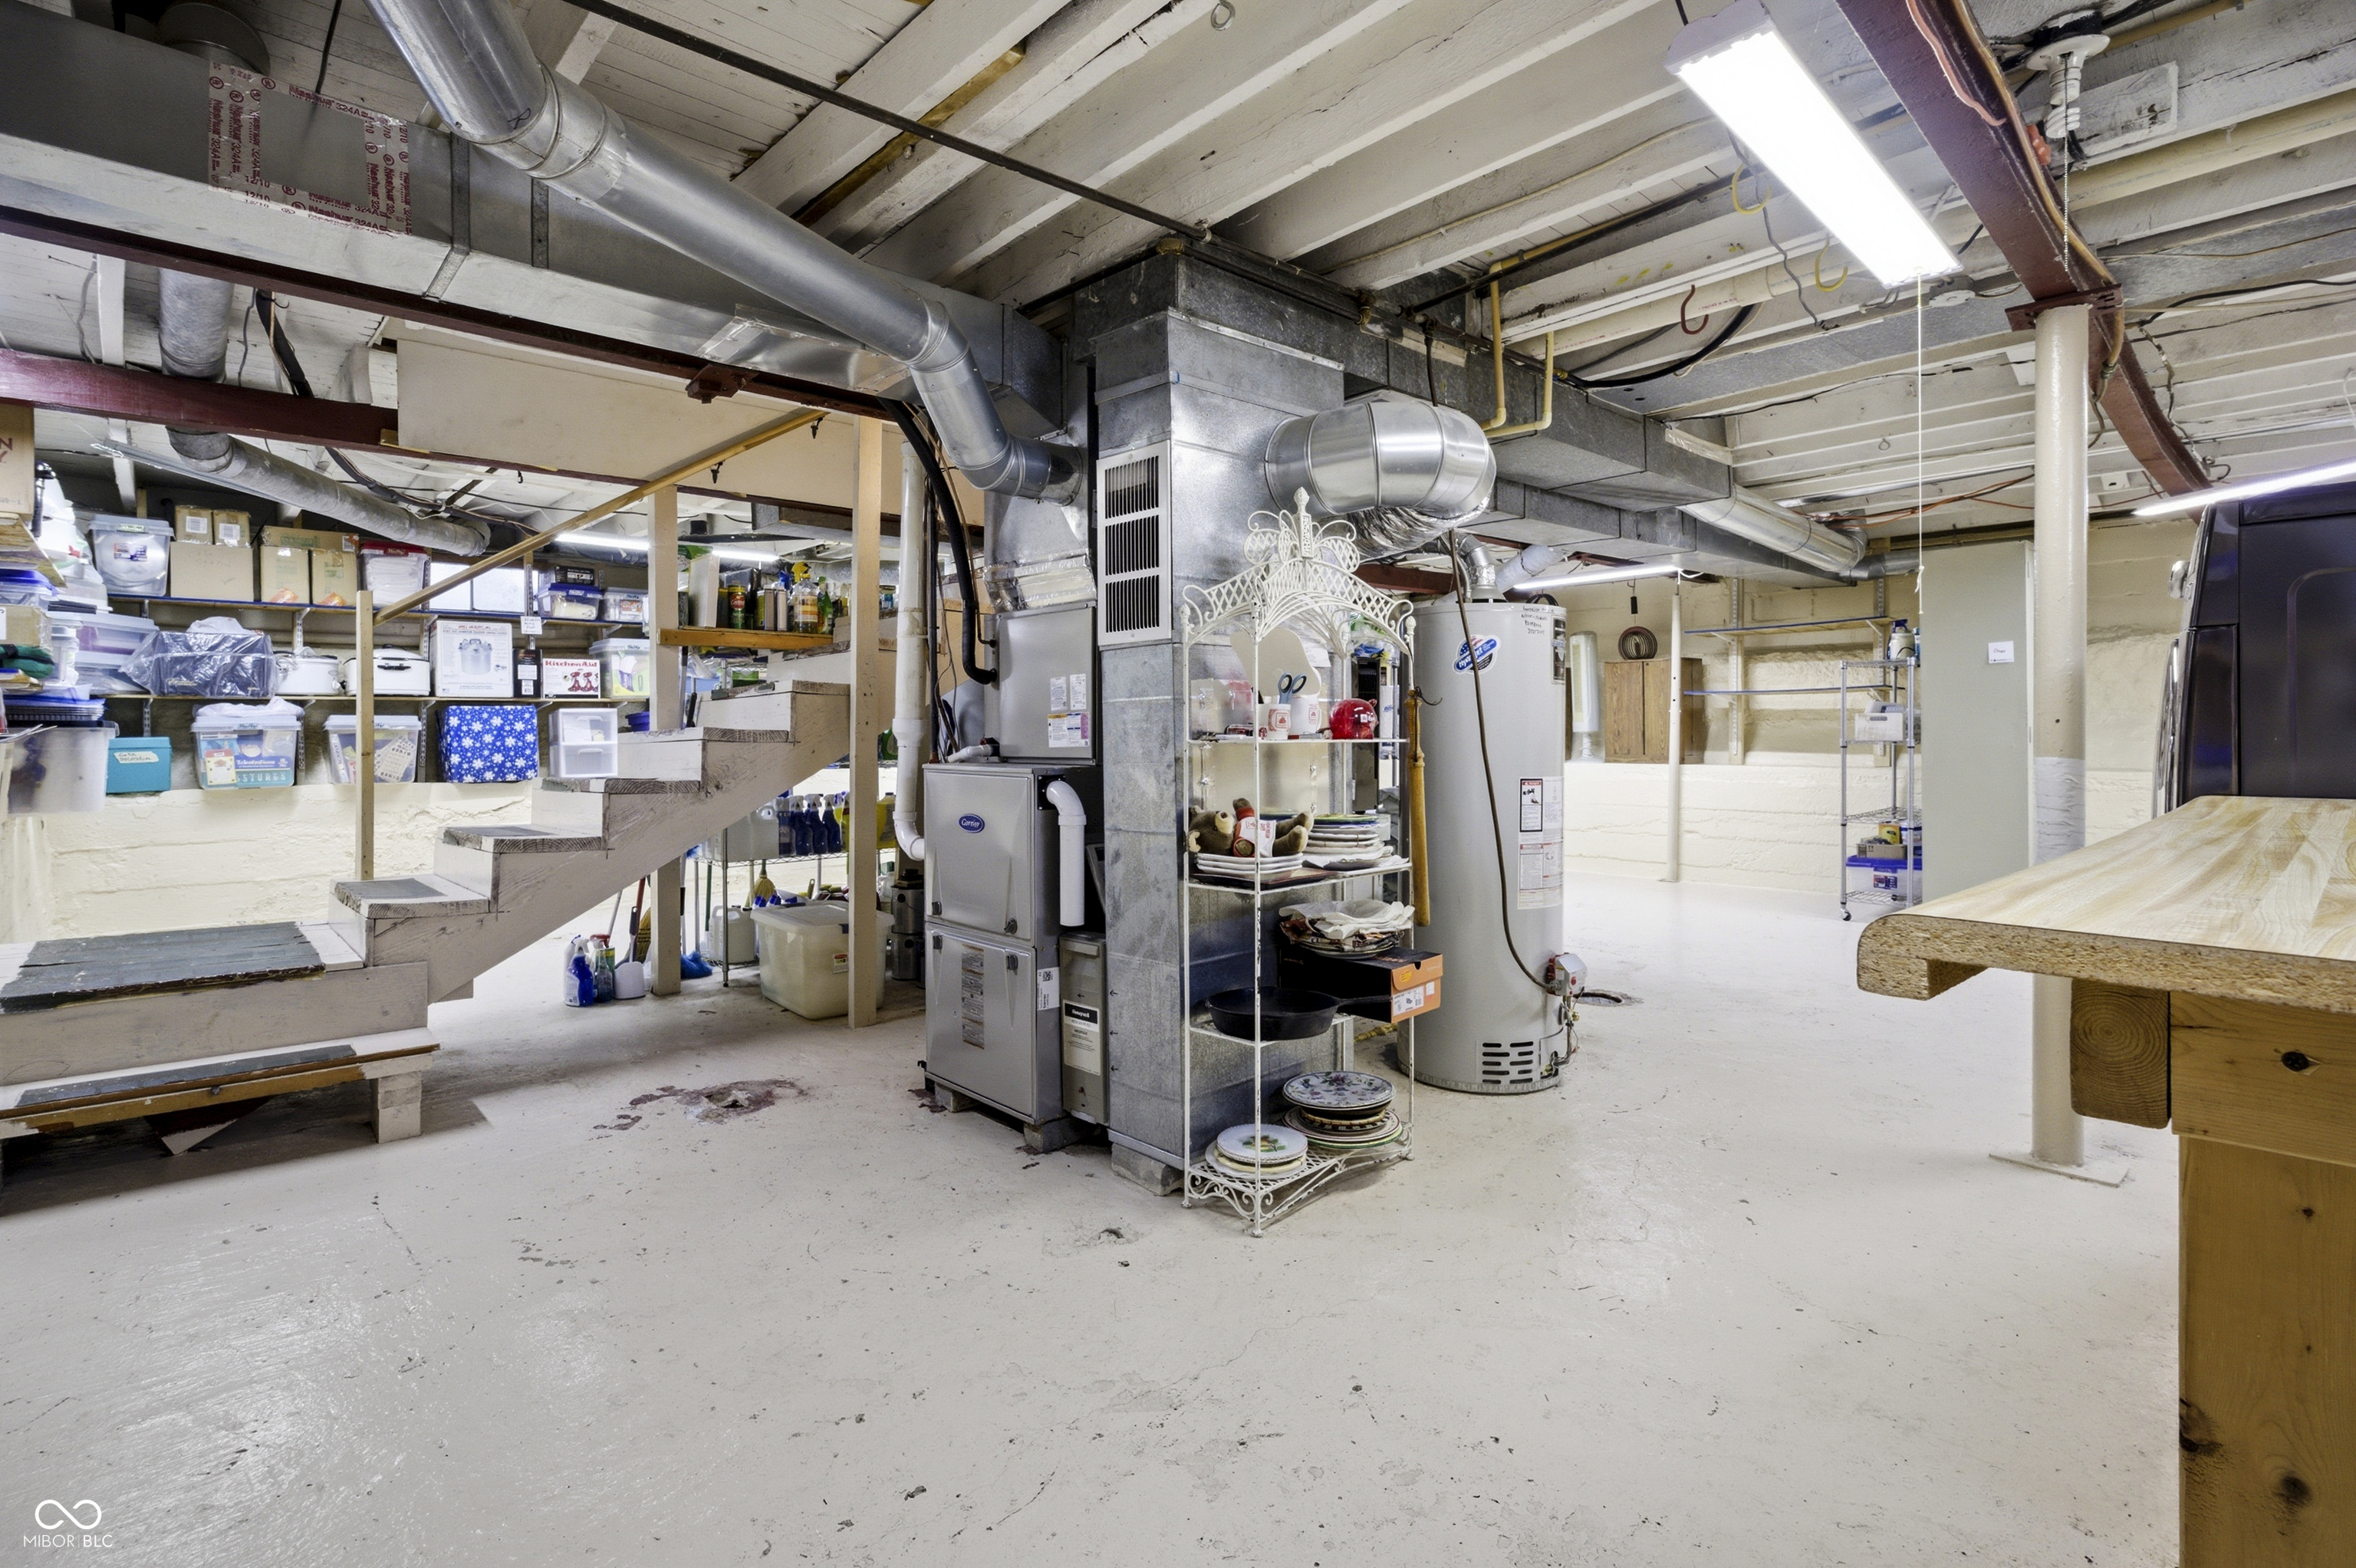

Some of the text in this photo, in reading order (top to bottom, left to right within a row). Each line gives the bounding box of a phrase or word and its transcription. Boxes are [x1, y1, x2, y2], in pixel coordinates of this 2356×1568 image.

[336, 102, 360, 117] 324A
[211, 98, 223, 159] Nashua 324A
[231, 103, 243, 163] Nashua 324A
[245, 176, 271, 189] 12/10
[245, 190, 271, 202] 12/10
[354, 218, 379, 230] 324A
[961, 818, 980, 828] Carrier
